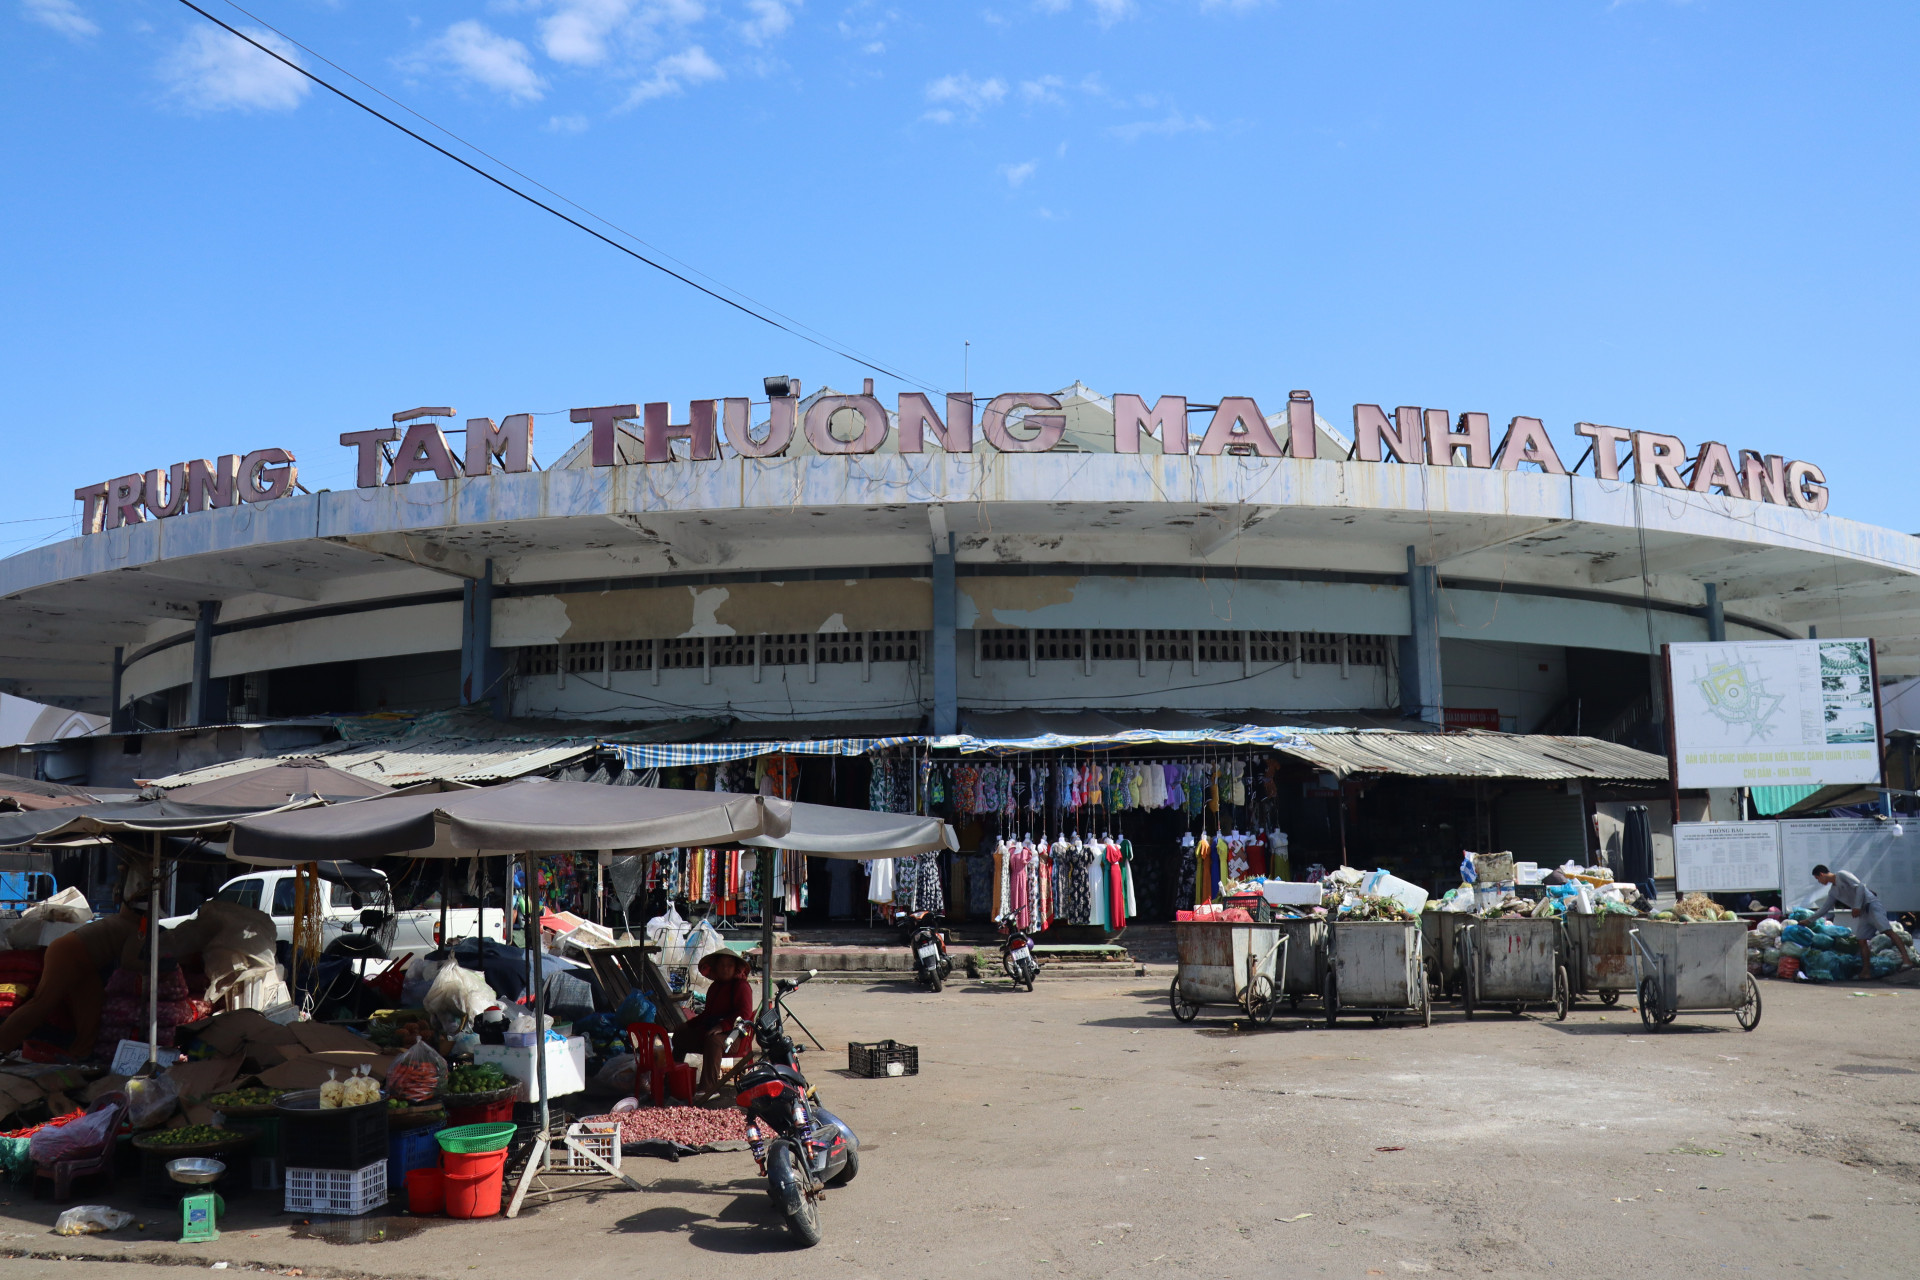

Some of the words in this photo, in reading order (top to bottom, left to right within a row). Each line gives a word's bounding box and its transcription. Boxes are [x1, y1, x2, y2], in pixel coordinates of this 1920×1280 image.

[74, 447, 298, 536] TRUNG
[340, 406, 534, 489] TÂM
[570, 377, 1067, 468] THƯƠNG
[1352, 403, 1567, 475] NHA
[1574, 422, 1829, 513] TRANG
[1778, 767, 1790, 777] NHA
[1792, 767, 1811, 777] TRANG
